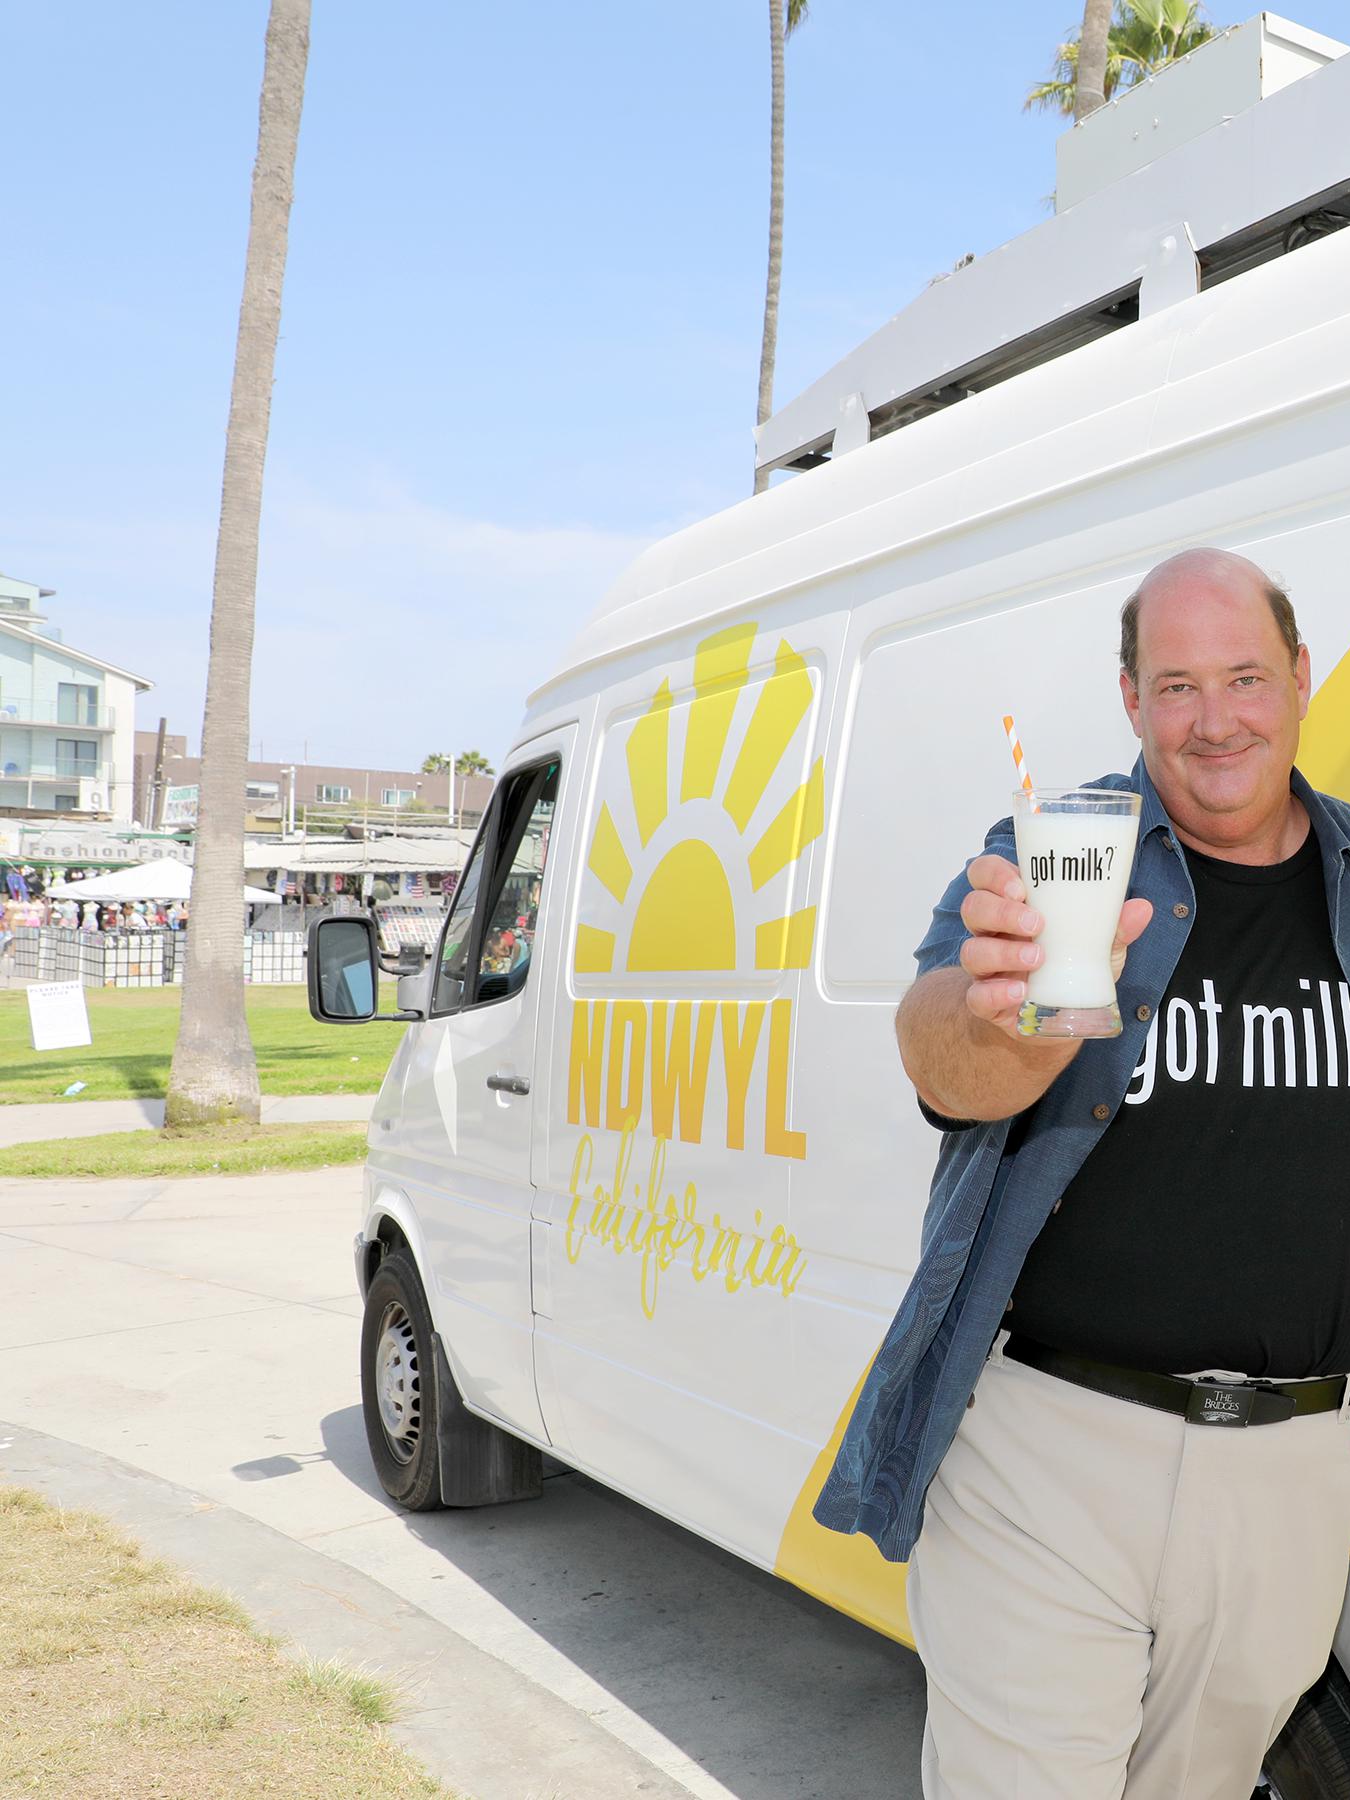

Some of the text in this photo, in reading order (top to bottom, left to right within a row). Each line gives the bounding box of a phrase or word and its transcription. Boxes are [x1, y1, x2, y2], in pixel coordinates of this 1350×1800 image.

[28, 842, 129, 859] Fashion
[1030, 846, 1114, 888] got milk?
[567, 998, 807, 1161] NDWYL
[565, 1114, 808, 1320] California
[1204, 1397, 1240, 1411] BRIDGES
[1214, 1390, 1233, 1402] THE
